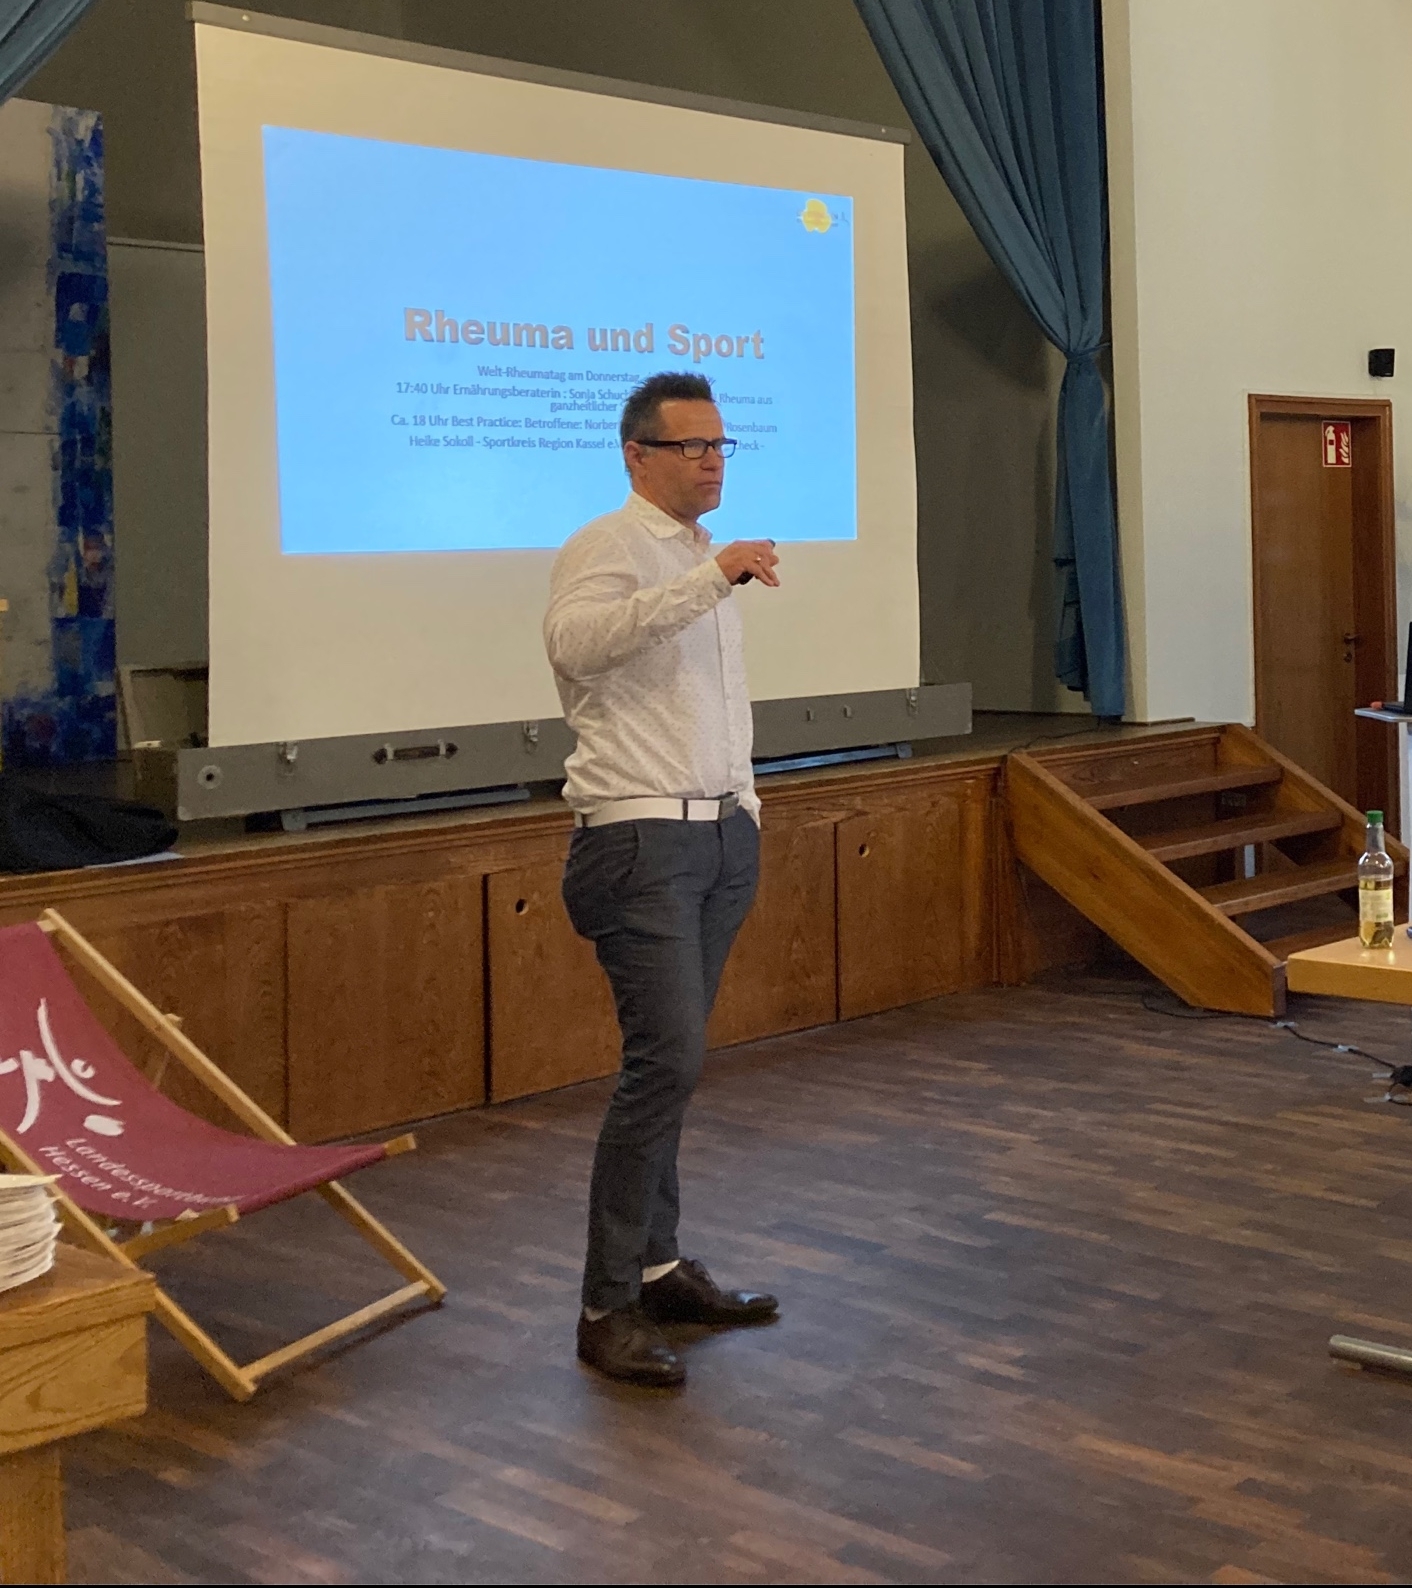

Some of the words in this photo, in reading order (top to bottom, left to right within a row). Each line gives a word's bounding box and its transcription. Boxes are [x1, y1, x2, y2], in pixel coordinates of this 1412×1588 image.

[403, 307, 575, 350] Rheuma
[588, 323, 655, 354] und
[667, 323, 765, 363] Sport
[477, 366, 566, 382] Welt-Rheumatag
[568, 371, 584, 381] am
[396, 382, 428, 394] 17:40
[430, 383, 450, 395] Uhr
[453, 383, 561, 399] Ernährungsberaterin
[569, 388, 596, 402] Sonja
[719, 393, 756, 405] Rheuma
[757, 396, 773, 405] aus
[550, 400, 618, 413] ganzheitlicher
[391, 414, 409, 426] Ca.
[412, 415, 426, 426] 18
[429, 415, 449, 427] Uhr
[452, 416, 474, 428] Best
[476, 416, 522, 429] Practice:
[585, 419, 618, 430] Norber
[726, 423, 778, 433] Rosenbaum
[409, 435, 440, 447] Heike
[483, 436, 537, 450] Sportkreis
[538, 437, 574, 451] Region
[575, 438, 606, 449] Kassel
